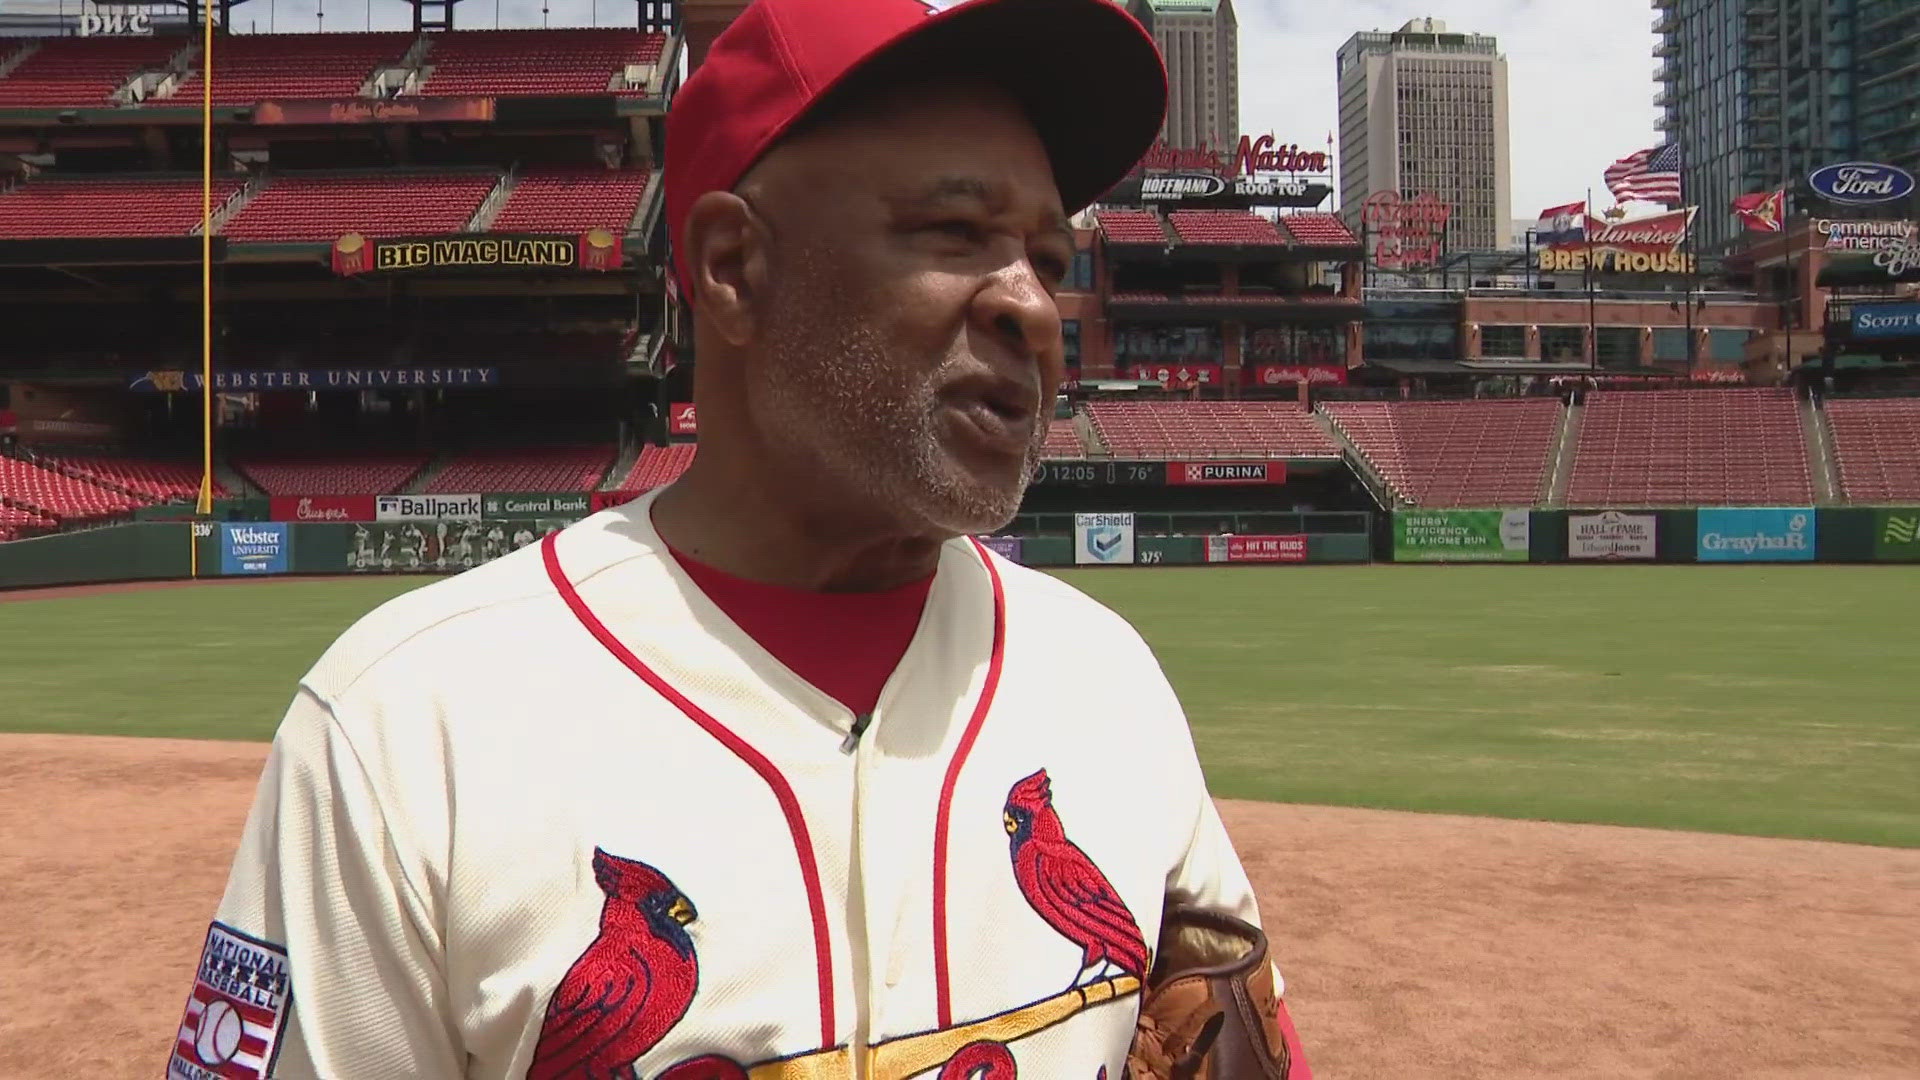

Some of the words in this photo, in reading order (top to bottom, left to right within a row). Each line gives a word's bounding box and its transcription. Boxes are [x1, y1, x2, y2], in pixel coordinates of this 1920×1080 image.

[80, 12, 151, 35] pwc
[1221, 135, 1328, 180] Nation
[1141, 178, 1211, 193] HOFFMANN
[1832, 166, 1894, 194] Ford
[1817, 219, 1913, 238] Community
[377, 244, 430, 270] BIG
[434, 240, 499, 265] MAC
[501, 240, 575, 266] LAND
[1539, 250, 1607, 270] BREW
[1615, 253, 1696, 273] HOUSE
[328, 368, 491, 387] UNIVERSITY
[1052, 466, 1096, 480] 12:05
[1205, 466, 1263, 478] PURINA
[402, 499, 478, 518] Ballpark
[504, 500, 551, 513] Central
[553, 498, 588, 511] Bank
[1076, 514, 1132, 527] CarShield
[1406, 517, 1449, 527] ENERGY
[230, 527, 280, 545] Webster
[1406, 527, 1470, 537] EFFICIENCY
[1430, 537, 1461, 545] HOME
[1463, 537, 1487, 545] RUN
[232, 545, 280, 556] UNIVERSITY
[210, 932, 288, 977] NATIONAL
[200, 968, 279, 1010] BASEBALL
